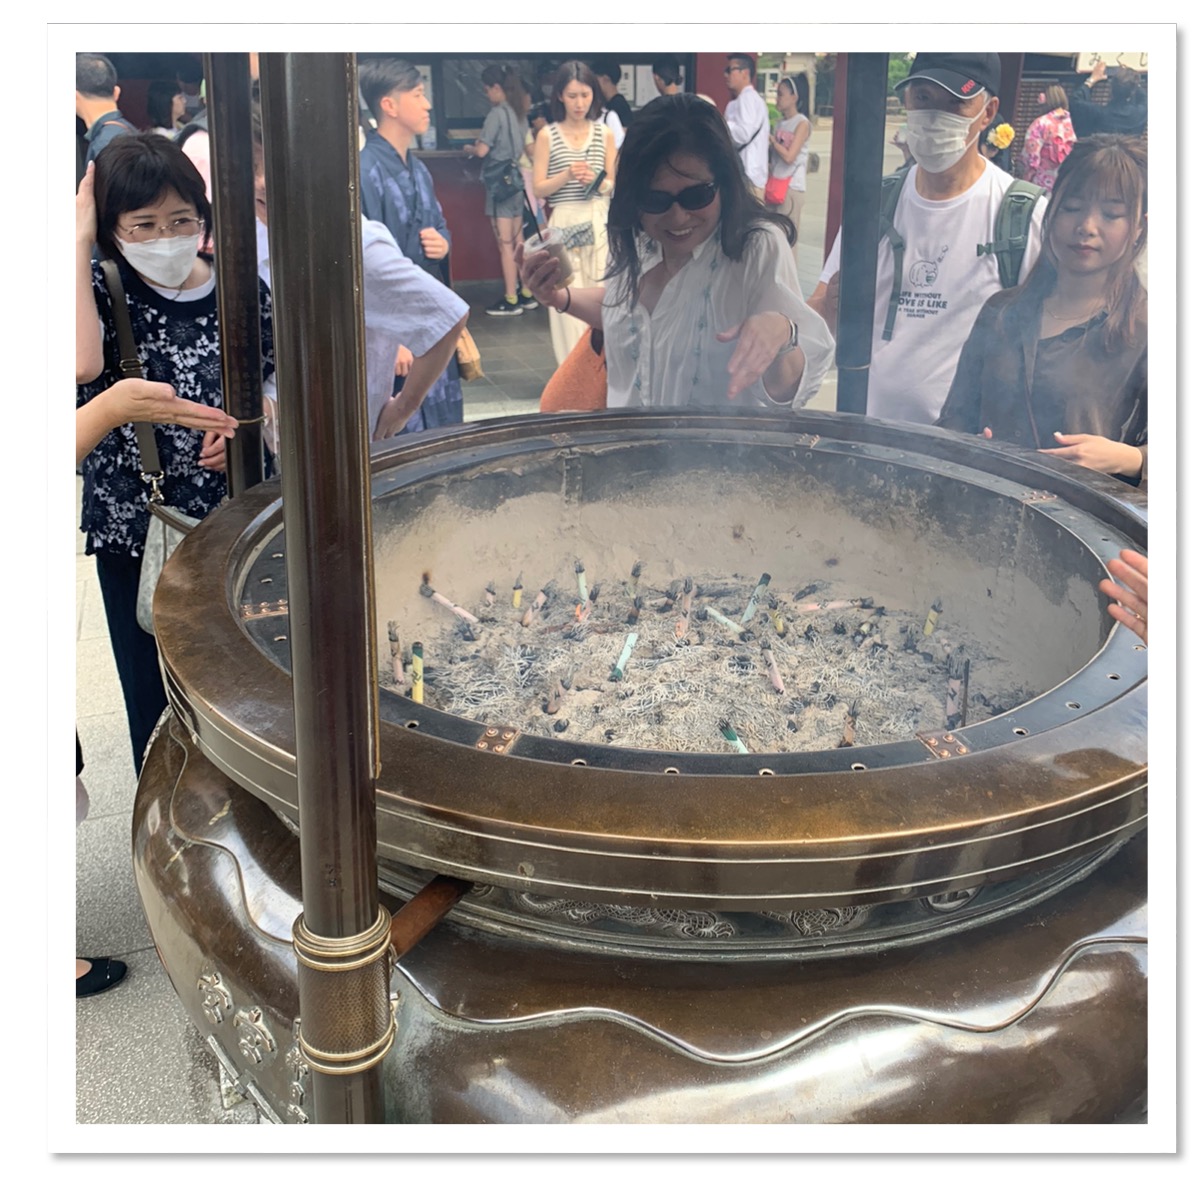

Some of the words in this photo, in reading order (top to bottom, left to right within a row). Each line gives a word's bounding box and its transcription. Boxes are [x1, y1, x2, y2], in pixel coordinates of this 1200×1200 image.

[898, 297, 915, 306] OVE
[917, 299, 925, 307] IS
[927, 300, 948, 309] LIKE
